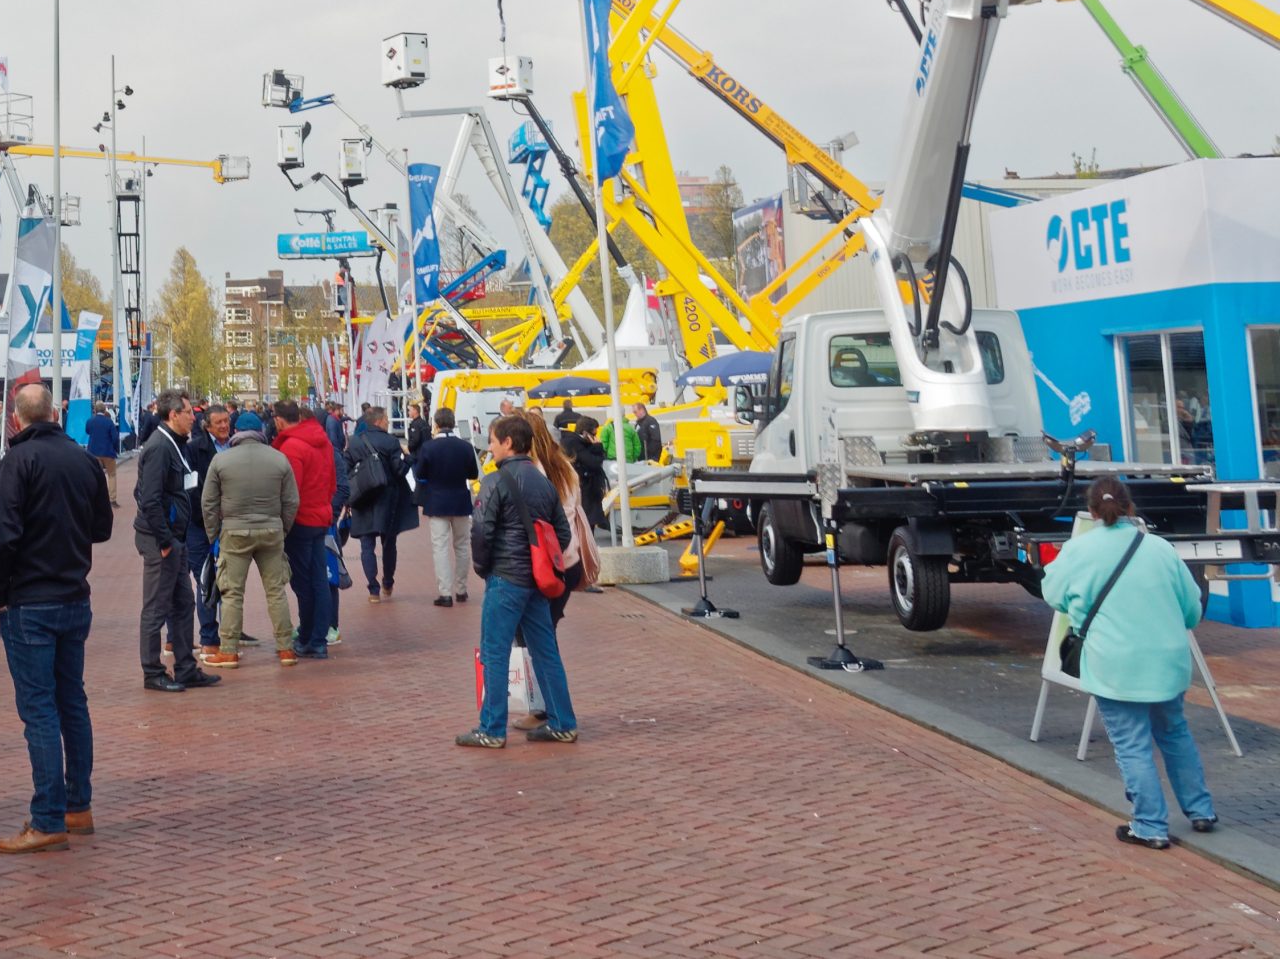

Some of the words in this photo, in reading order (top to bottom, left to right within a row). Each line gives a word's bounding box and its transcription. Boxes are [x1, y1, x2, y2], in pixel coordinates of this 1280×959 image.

[706, 65, 764, 114] KORS
[291, 236, 320, 252] Collé
[334, 242, 357, 250] SALES
[1070, 198, 1131, 271] CTE
[685, 296, 701, 332] 4200
